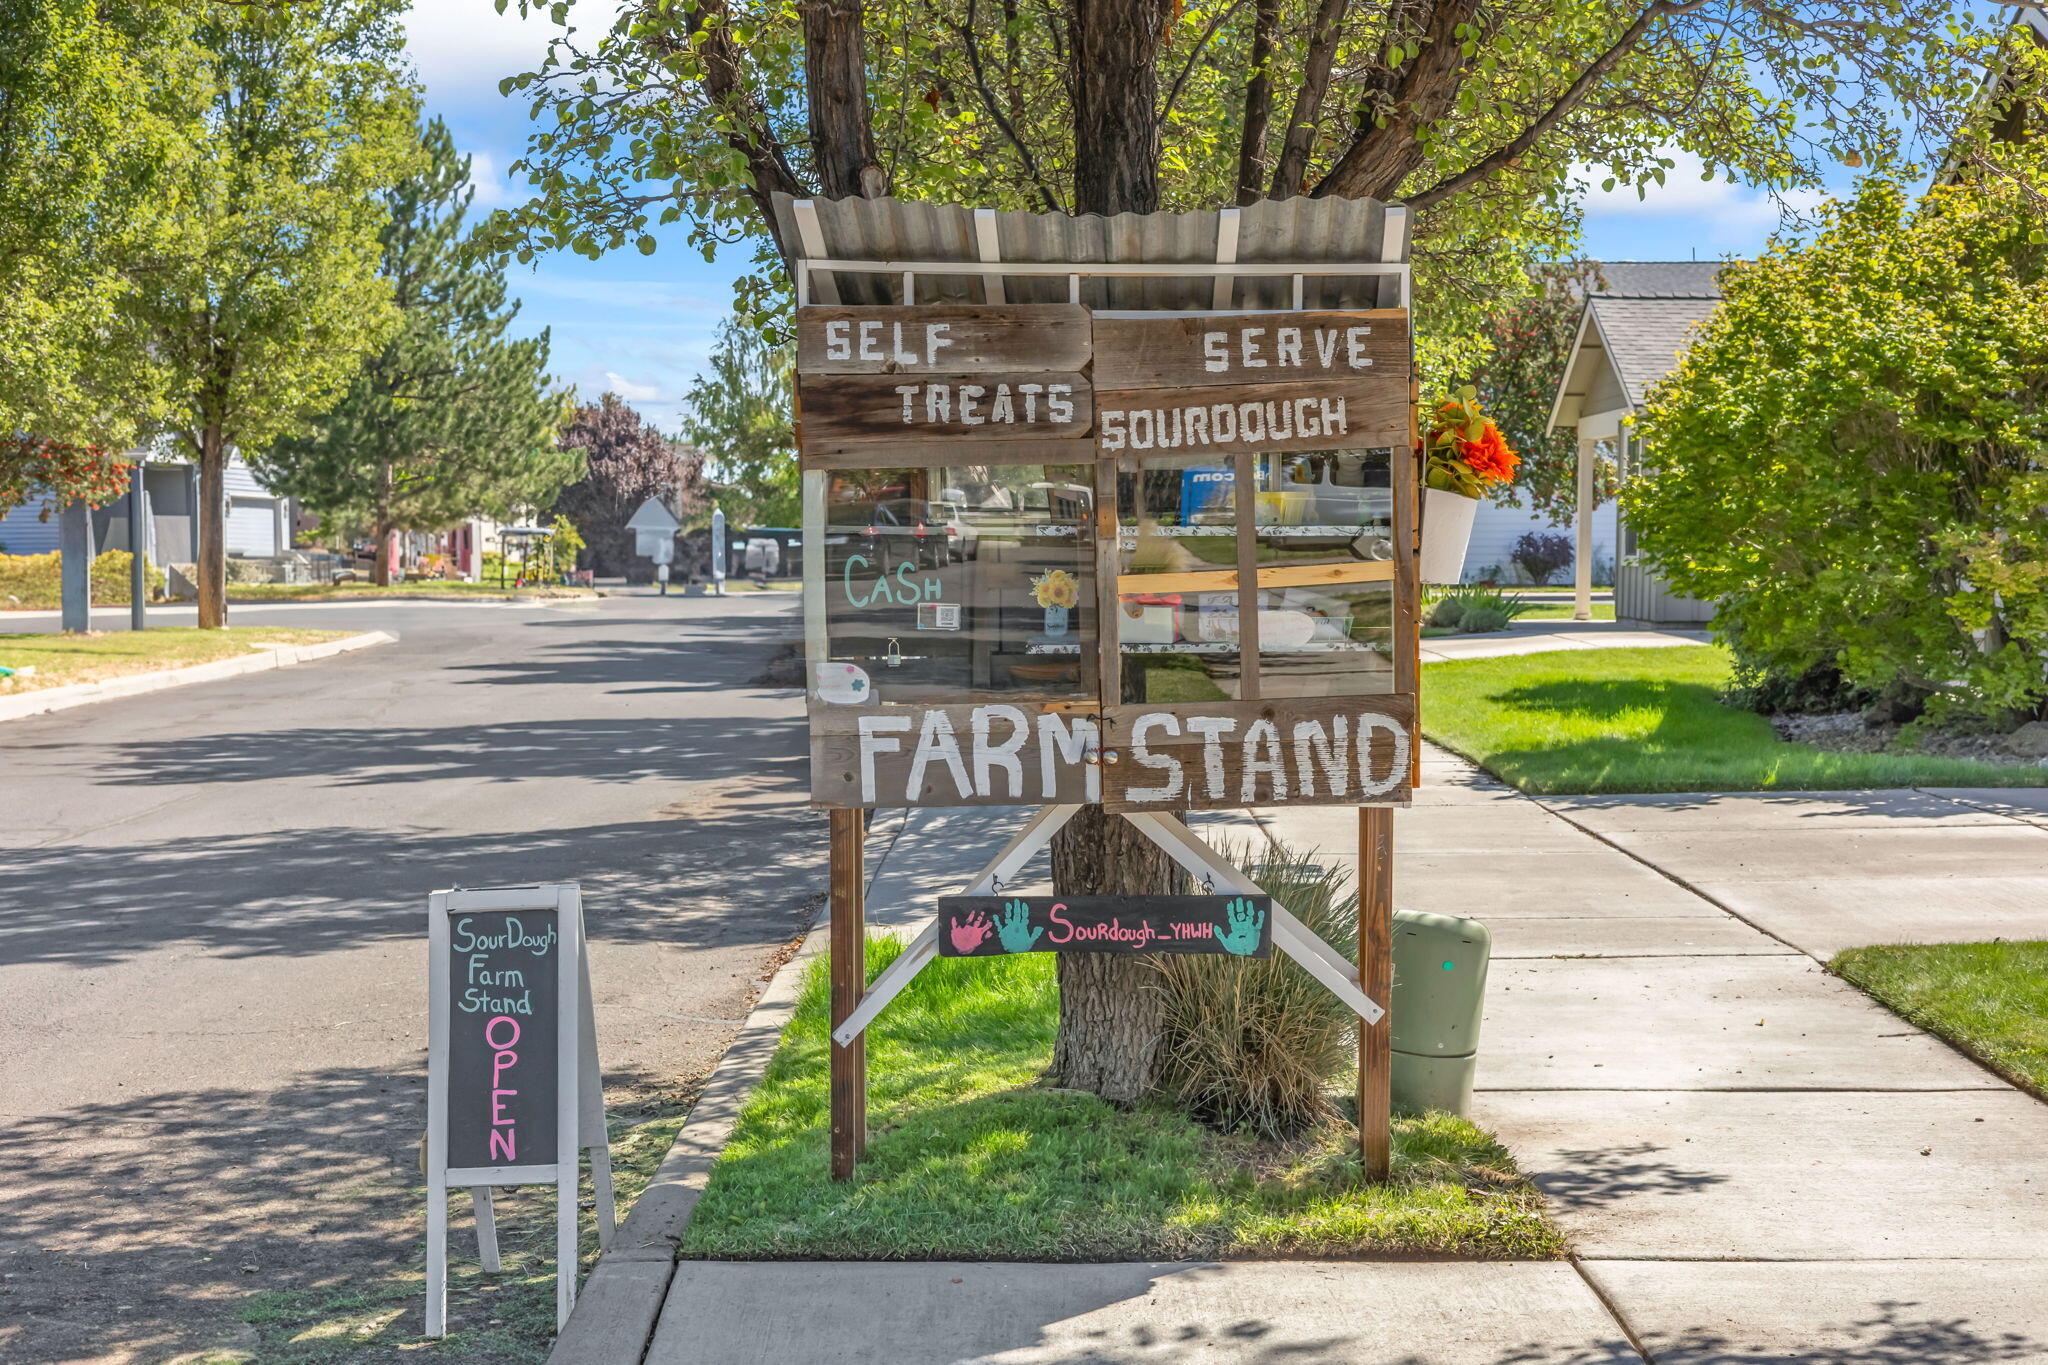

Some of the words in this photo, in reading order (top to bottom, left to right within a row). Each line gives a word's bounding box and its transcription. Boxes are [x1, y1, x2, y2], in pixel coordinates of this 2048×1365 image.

[826, 320, 954, 367] SELF
[1204, 326, 1373, 373] SERVE
[895, 384, 1074, 425] TREATS
[1102, 396, 1347, 450] SOURDOUGH
[844, 554, 942, 608] CASH
[858, 704, 1101, 805] FARM
[1125, 712, 1410, 804] STAND
[468, 953, 524, 988] Farm
[457, 988, 533, 1016] Stand
[485, 1015, 521, 1162] OPEN
